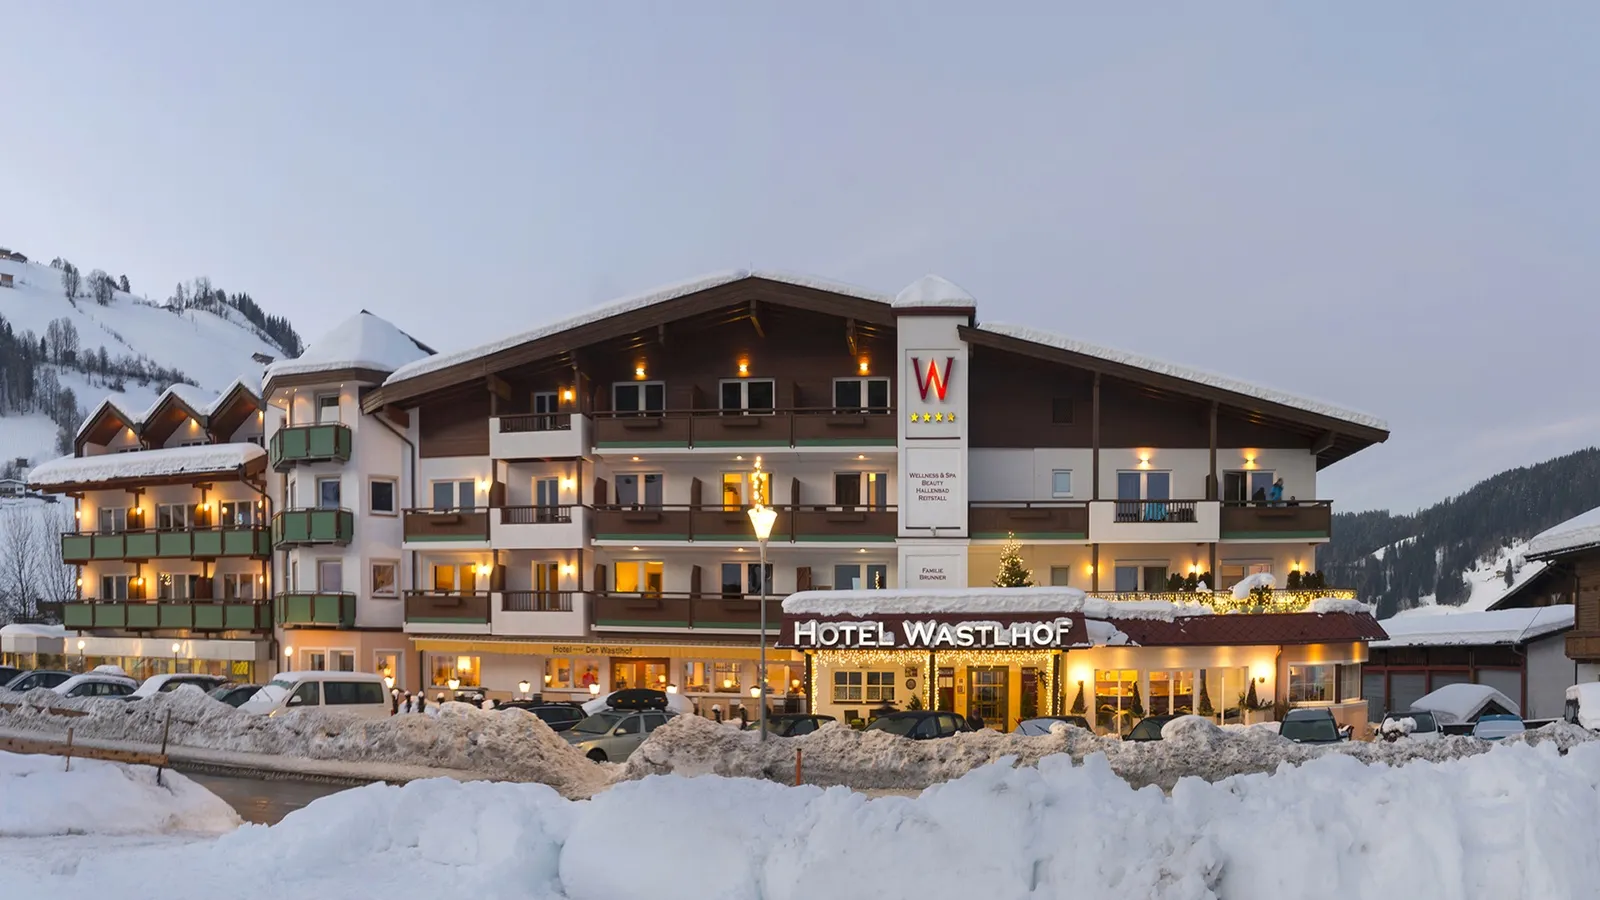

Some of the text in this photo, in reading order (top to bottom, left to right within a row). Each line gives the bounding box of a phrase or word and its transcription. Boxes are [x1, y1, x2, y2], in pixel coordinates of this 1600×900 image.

[911, 356, 955, 402] W
[794, 621, 1070, 646] HOTEL WASTLHOF
[600, 646, 632, 654] Wastlhof
